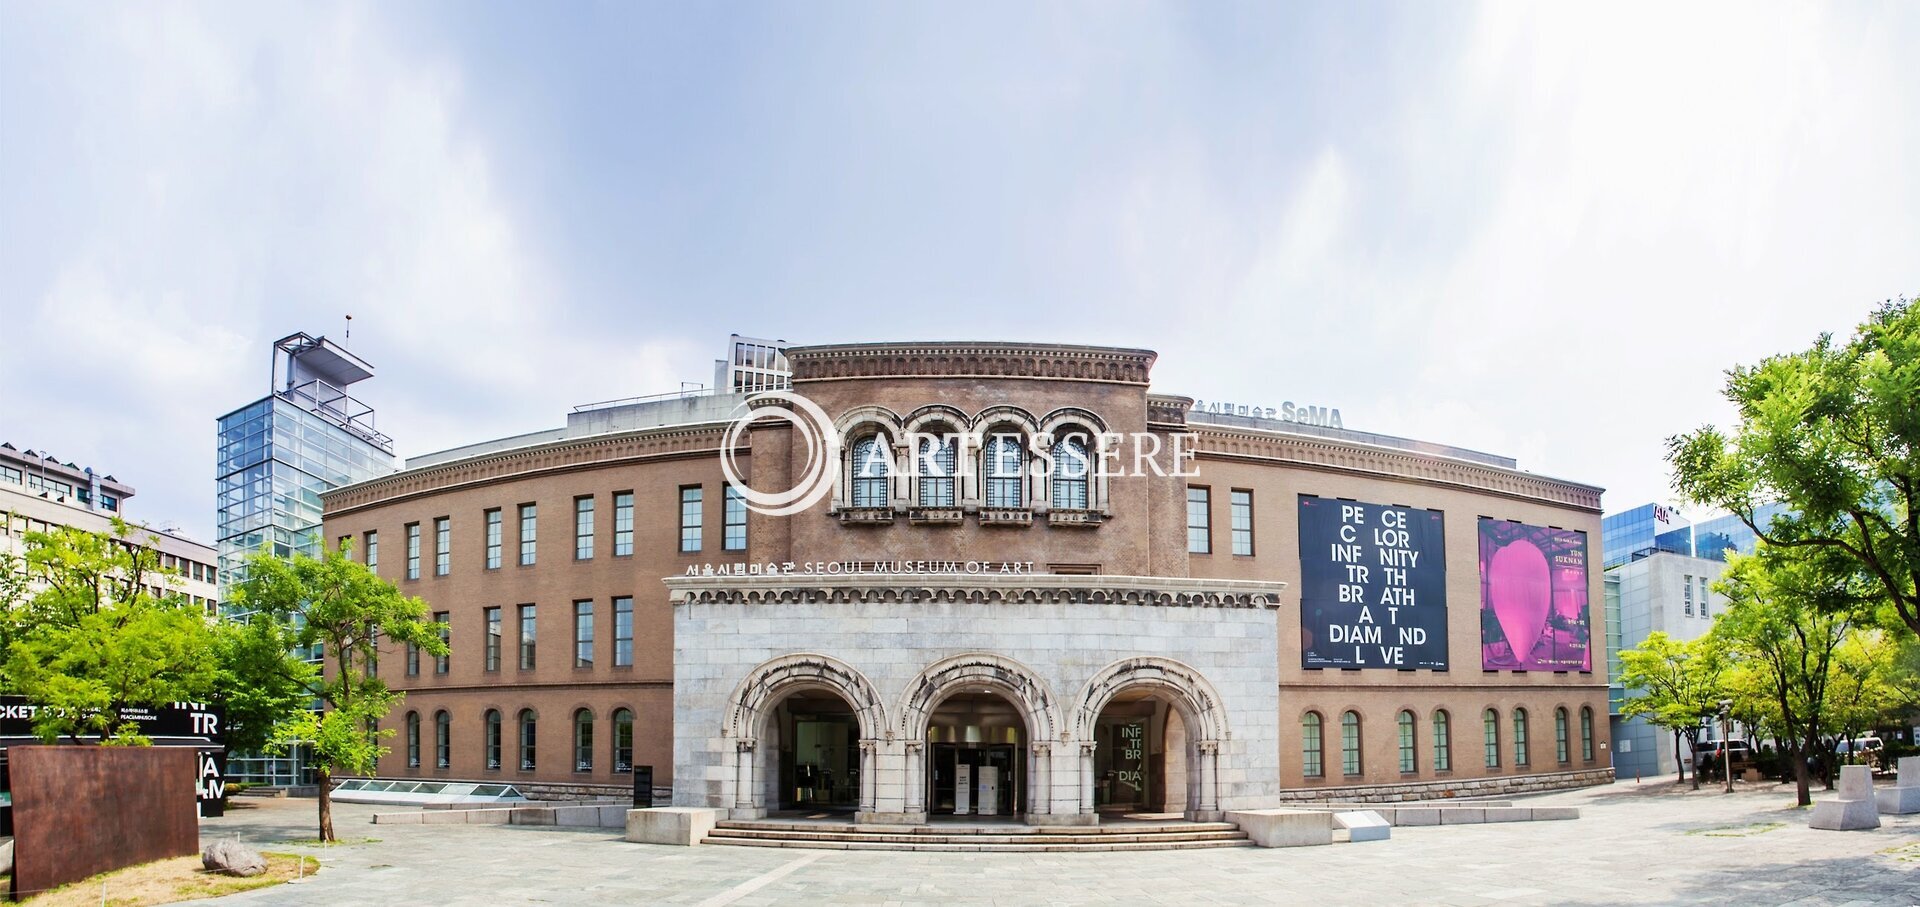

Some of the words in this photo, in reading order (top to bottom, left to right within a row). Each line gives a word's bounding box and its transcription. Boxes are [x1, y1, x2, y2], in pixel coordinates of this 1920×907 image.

[1281, 401, 1344, 429] SeMA
[1342, 505, 1364, 525] PE
[1381, 510, 1407, 529] CE
[1654, 505, 1670, 525] AIA
[1340, 525, 1356, 543] C
[1374, 528, 1410, 548] LOR
[1331, 543, 1362, 563] INF
[1379, 548, 1419, 568] NITY
[685, 561, 796, 576] 서울시립미술관
[804, 561, 864, 575] SEOUL
[873, 560, 958, 574] MUSEUM
[965, 561, 991, 574] OF
[999, 561, 1034, 574] ART
[1346, 564, 1369, 584] TR
[1384, 568, 1407, 587] TH
[1338, 584, 1364, 603] BR
[1380, 587, 1415, 606] ATH
[1358, 605, 1374, 624] A
[1388, 607, 1399, 625] T
[1329, 624, 1382, 644] DIAM
[1399, 627, 1427, 645] ND
[1355, 645, 1366, 664] L
[1380, 646, 1404, 665] VE
[190, 712, 218, 734] TR
